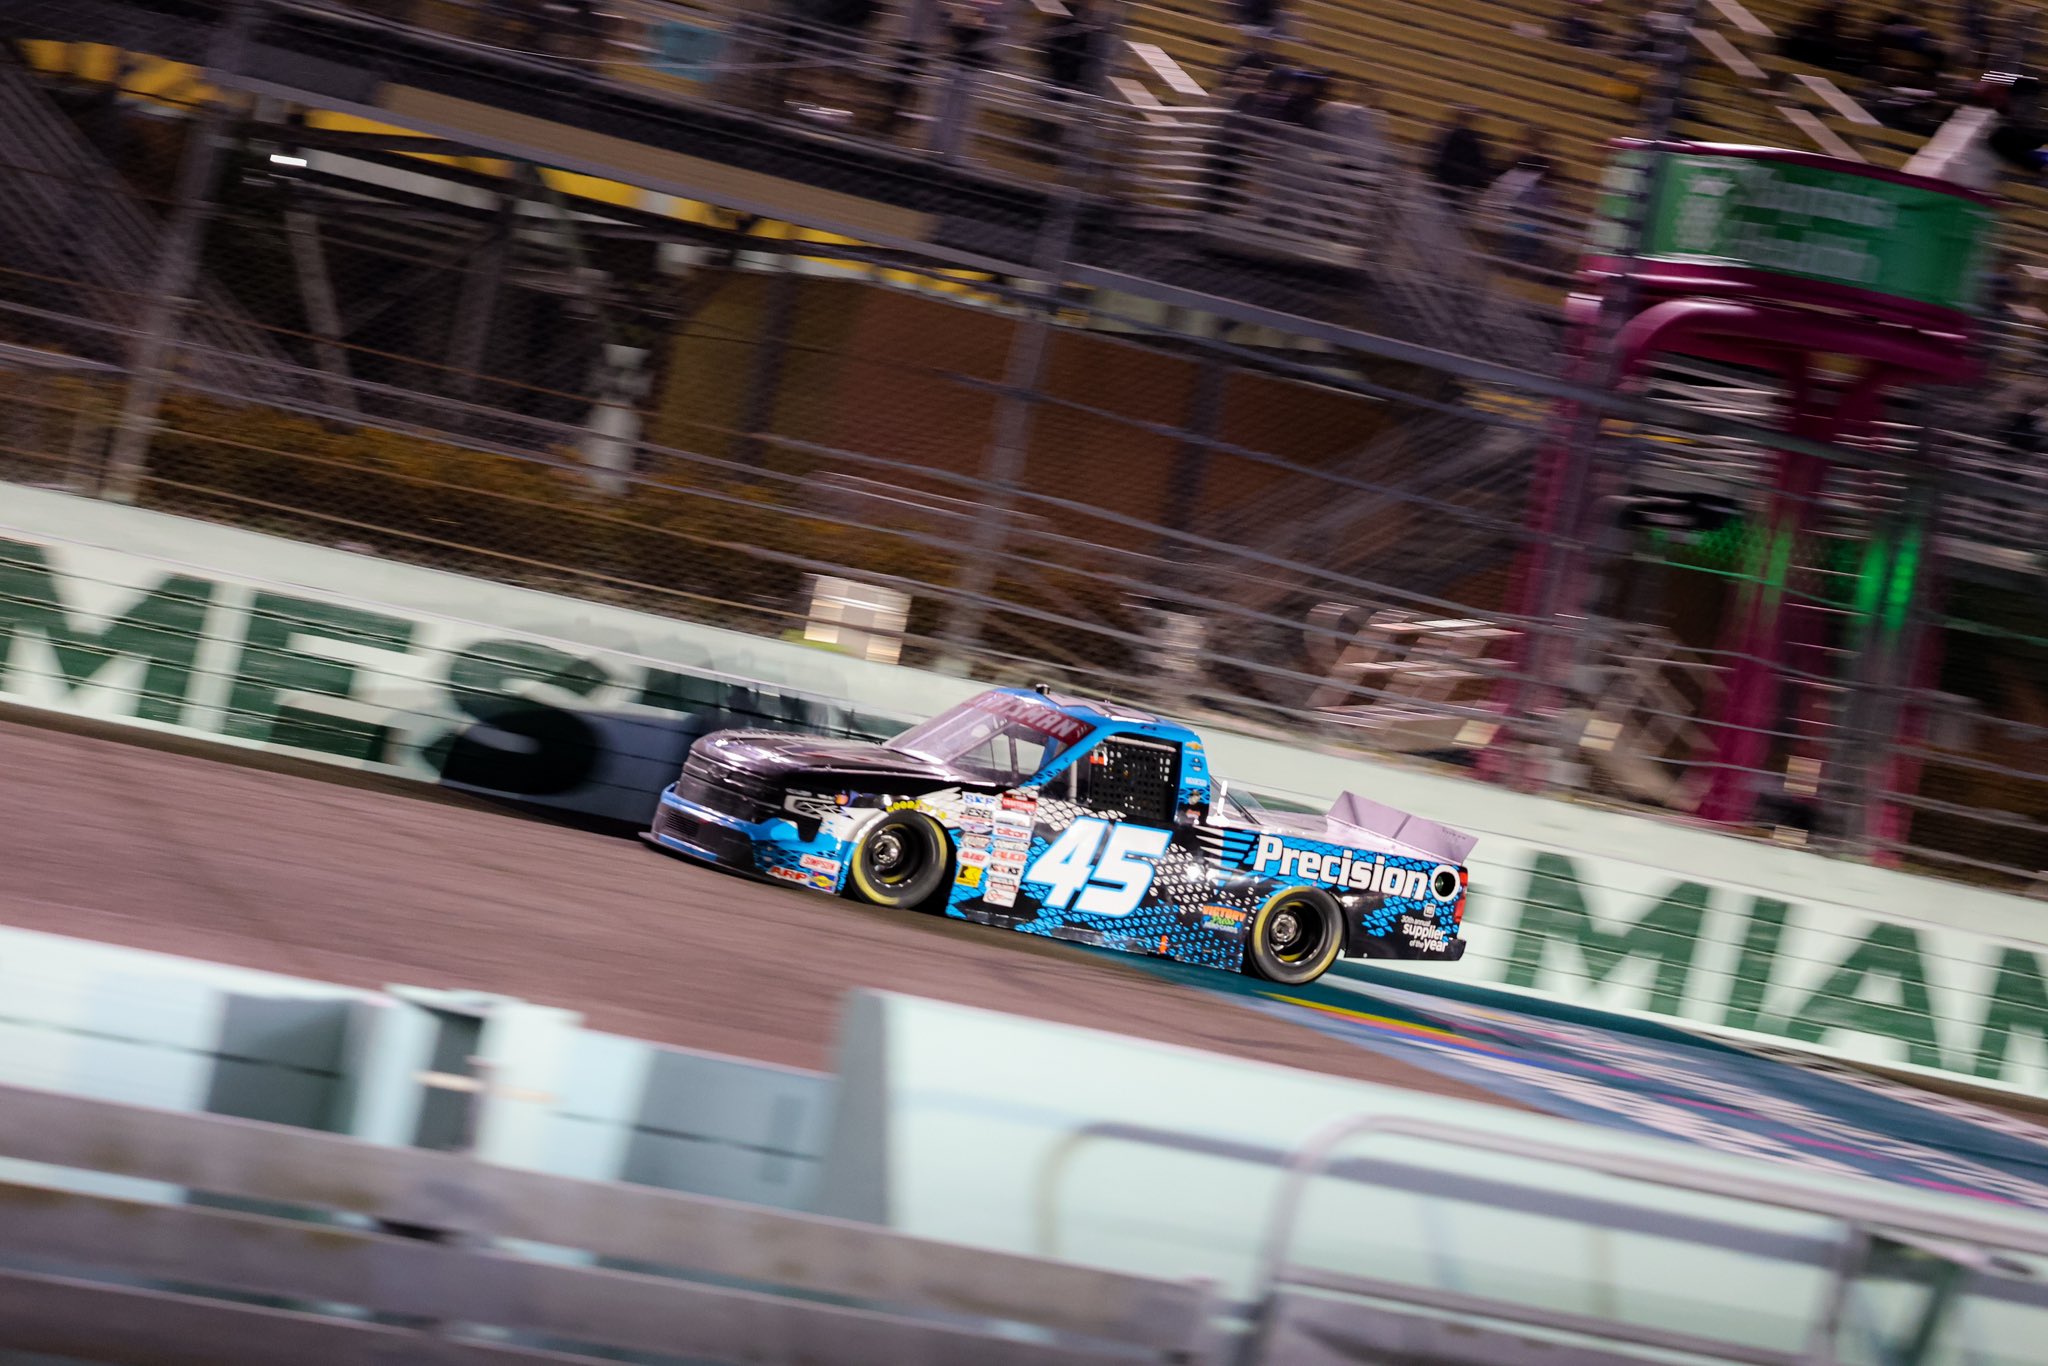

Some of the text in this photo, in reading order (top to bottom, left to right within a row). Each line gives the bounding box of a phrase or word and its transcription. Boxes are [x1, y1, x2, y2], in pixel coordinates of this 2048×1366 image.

[0, 537, 690, 796] MES
[964, 794, 994, 806] SKF
[803, 857, 835, 871] SIMPSON
[1023, 816, 1173, 918] 45
[1253, 834, 1428, 901] Precision
[769, 867, 808, 881] ARP
[1402, 924, 1446, 940] supplier
[1423, 938, 1449, 953] year
